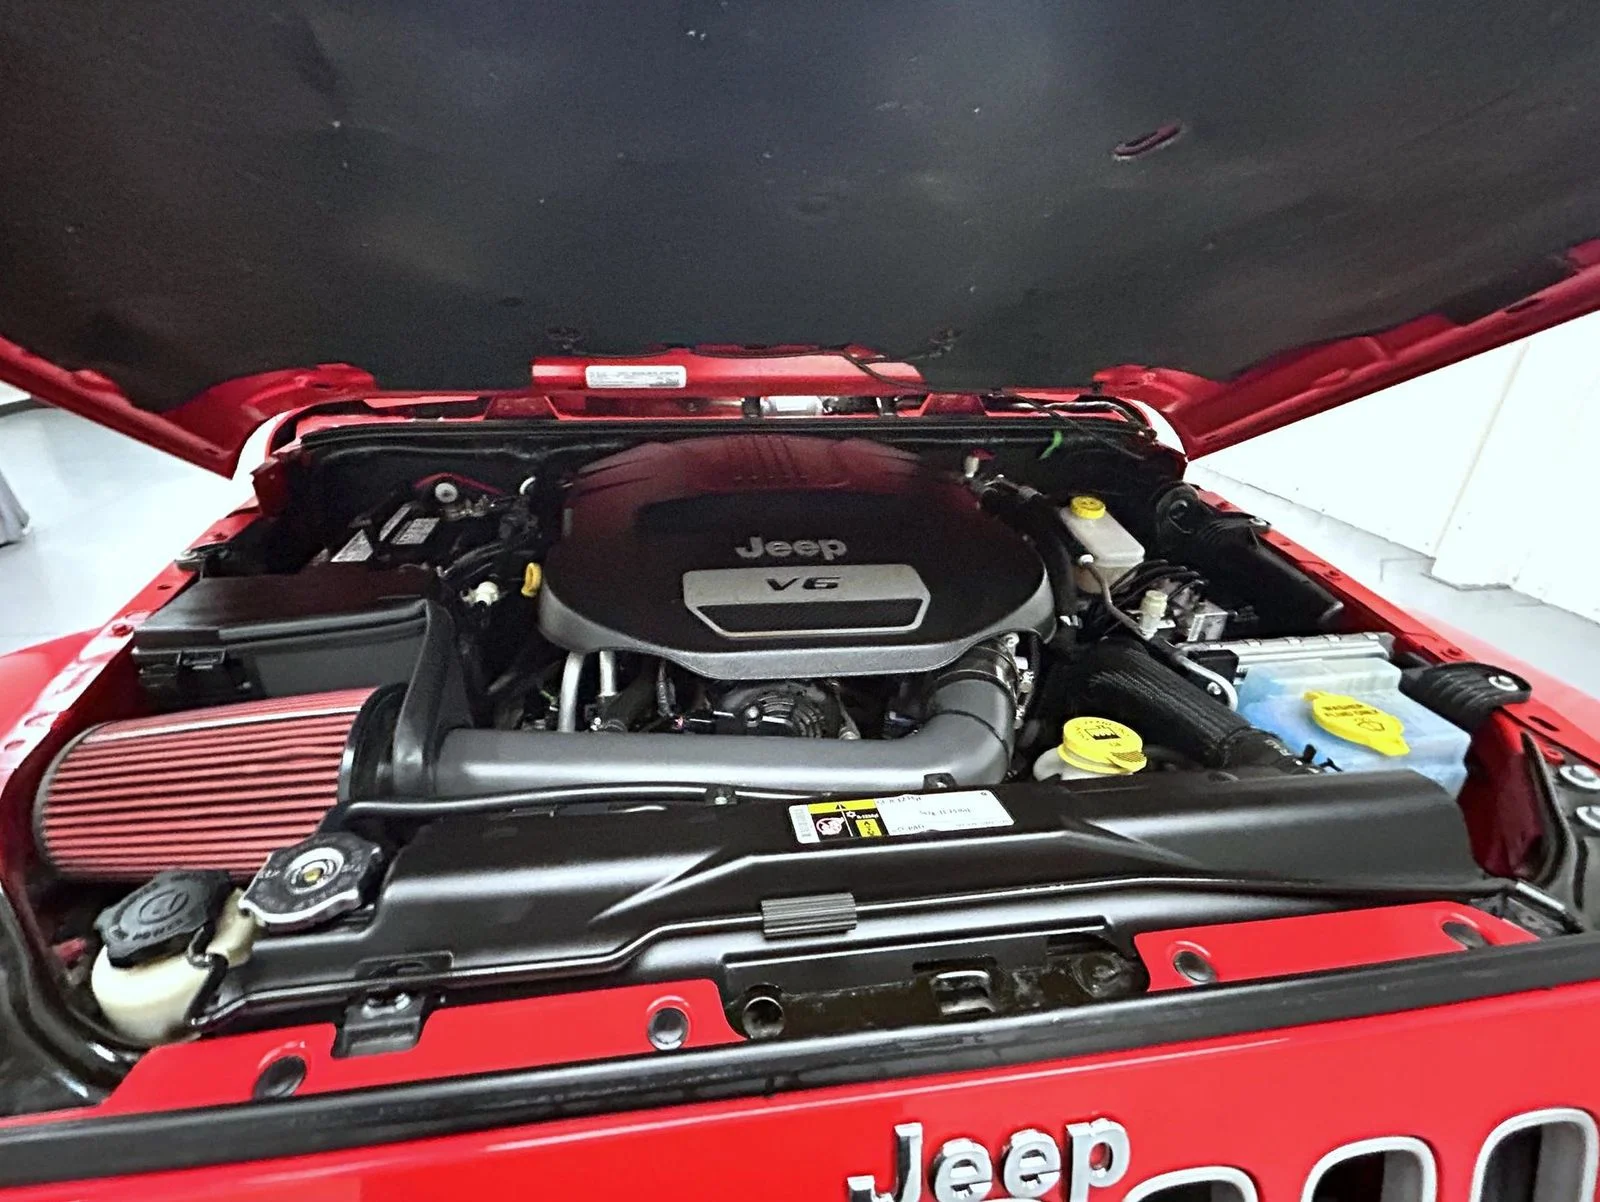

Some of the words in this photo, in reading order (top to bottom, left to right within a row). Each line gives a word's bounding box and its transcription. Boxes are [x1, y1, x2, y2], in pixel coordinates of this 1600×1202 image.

[735, 536, 847, 561] Jeep
[766, 576, 841, 591] V6
[847, 1117, 1131, 1202] Jeep
